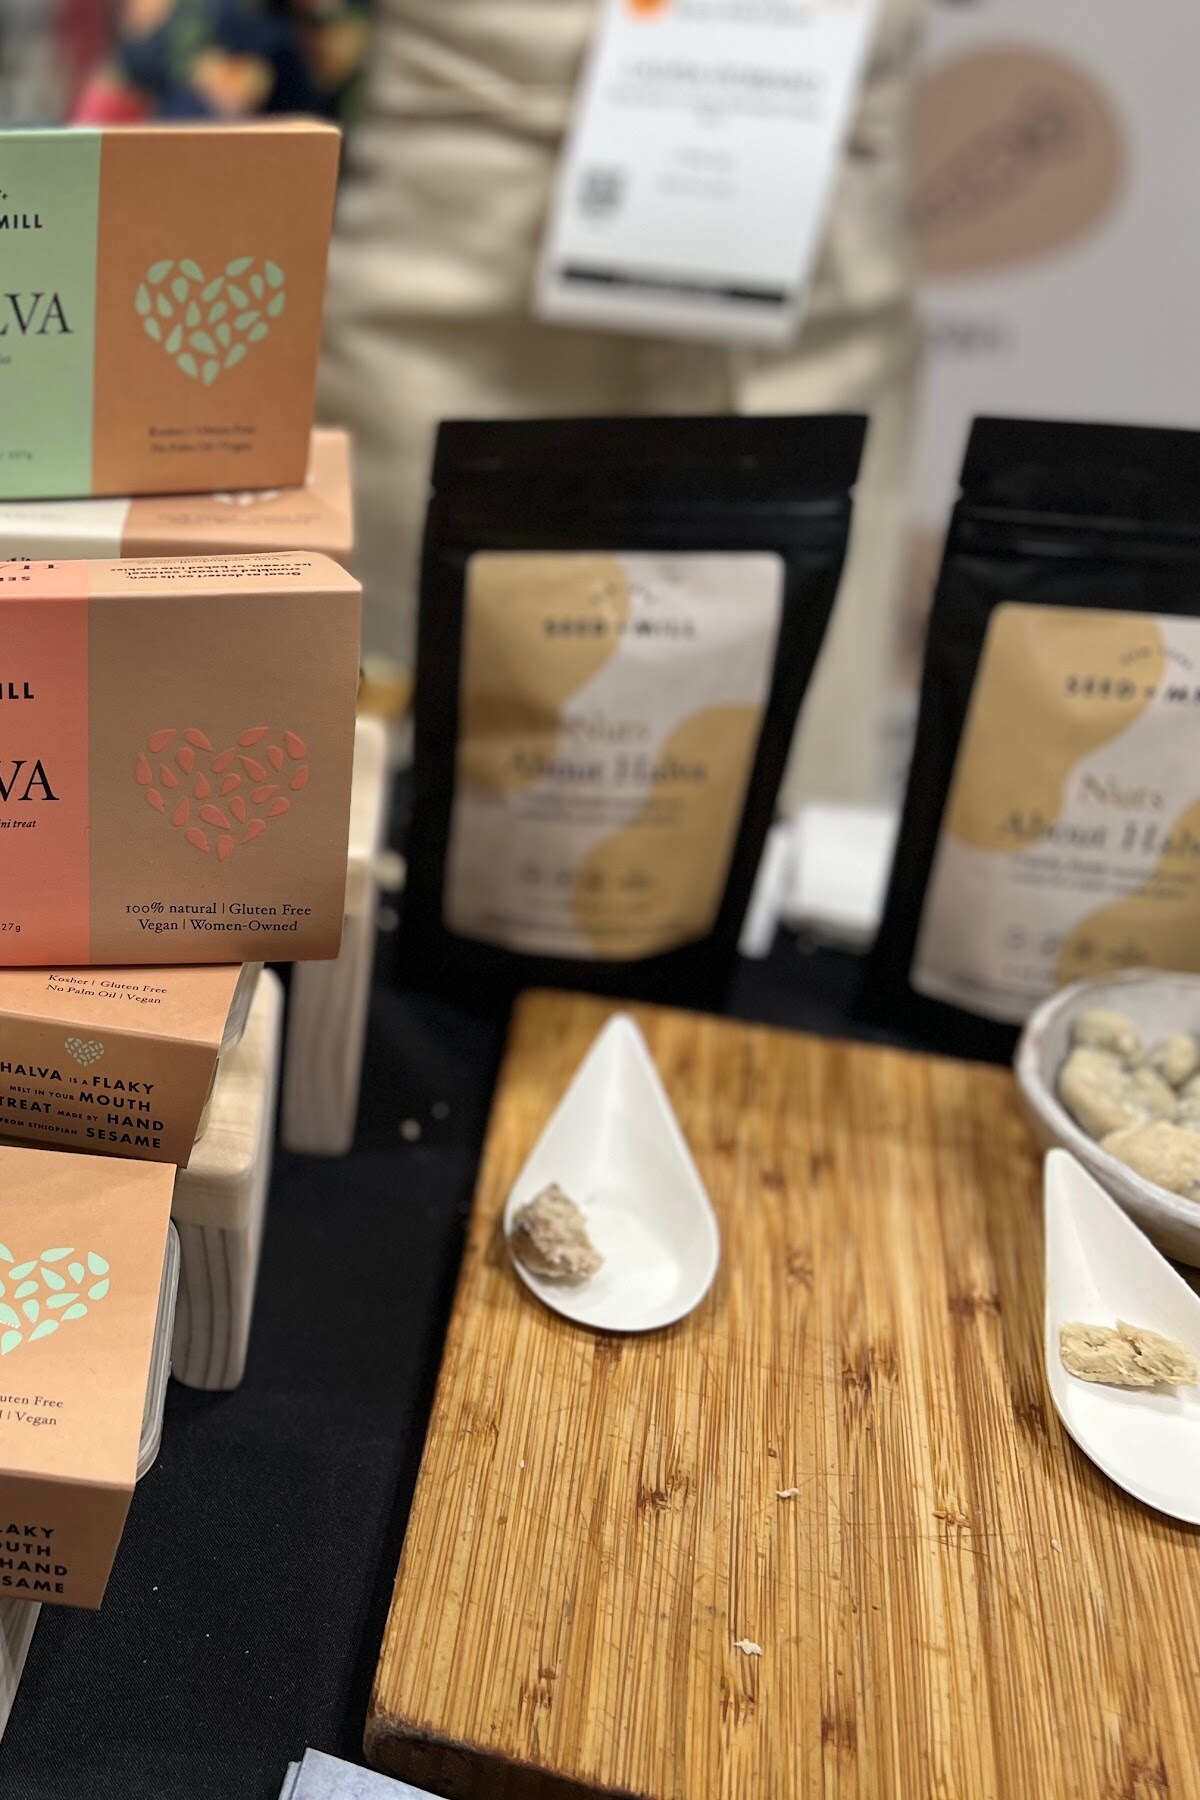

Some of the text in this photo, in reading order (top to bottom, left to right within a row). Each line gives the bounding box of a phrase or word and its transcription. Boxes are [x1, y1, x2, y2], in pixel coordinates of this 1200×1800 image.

[12, 819, 36, 829] treat
[125, 902, 164, 914] 100%
[169, 902, 217, 915] natural
[229, 902, 278, 916] Gluten
[282, 903, 311, 916] Free
[139, 919, 178, 932] Vegan
[190, 918, 297, 931] Women-Owned
[0, 1061, 62, 1081] HALVA
[93, 1076, 155, 1095] FLAKY
[9, 1085, 30, 1093] MELT
[48, 1092, 74, 1100] YOUR
[79, 1092, 150, 1112] MOUTH
[57, 1110, 82, 1119] MADE
[107, 1113, 164, 1131] HAND
[0, 1117, 161, 1149] FROM ETHIOPIAN SESAME
[34, 1396, 64, 1408] Free
[16, 1411, 57, 1427] Vegan
